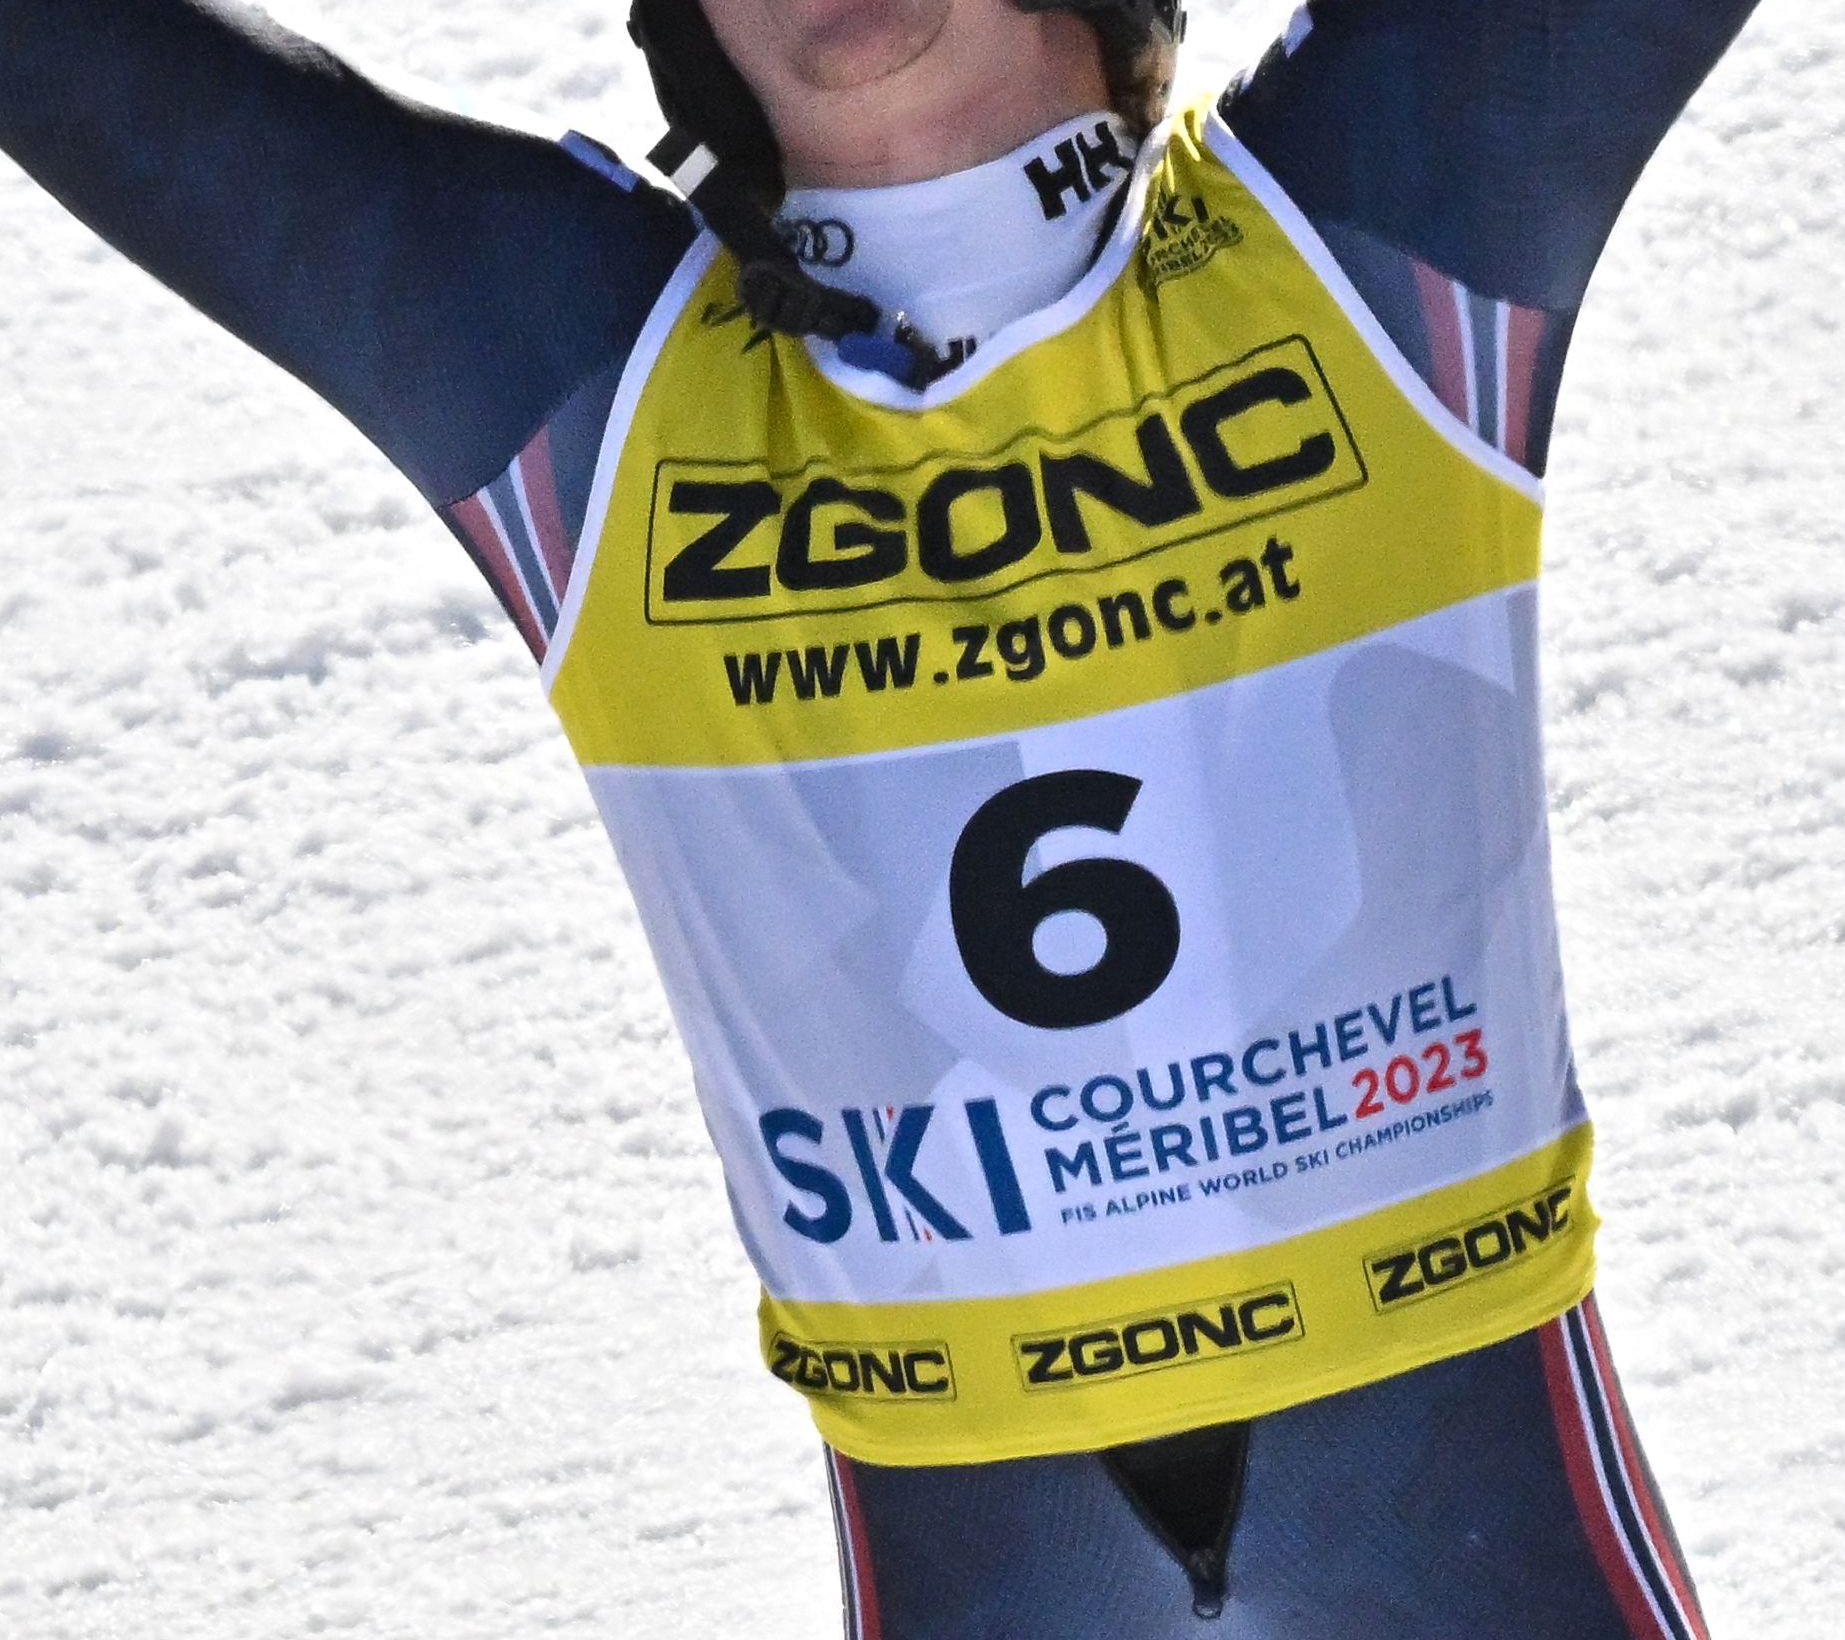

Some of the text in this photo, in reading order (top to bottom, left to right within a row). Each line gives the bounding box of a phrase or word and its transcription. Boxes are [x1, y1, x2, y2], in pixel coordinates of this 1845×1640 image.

[663, 367, 1335, 601] ZGONC
[724, 536, 1300, 706] www.zgonc.at
[949, 769, 1180, 1030] 6
[1030, 975, 1477, 1132] COURCHEVEL
[1044, 1028, 1488, 1193] MÉRIBEL 2023
[759, 1096, 1031, 1244] SKI
[1060, 1089, 1495, 1225] FIS ALPINE WORLD SKI CHAMPIONSHIPS
[1372, 1187, 1572, 1303] ZGONC
[771, 1339, 949, 1394] ZGONC
[1020, 1291, 1294, 1383] ZGONC
